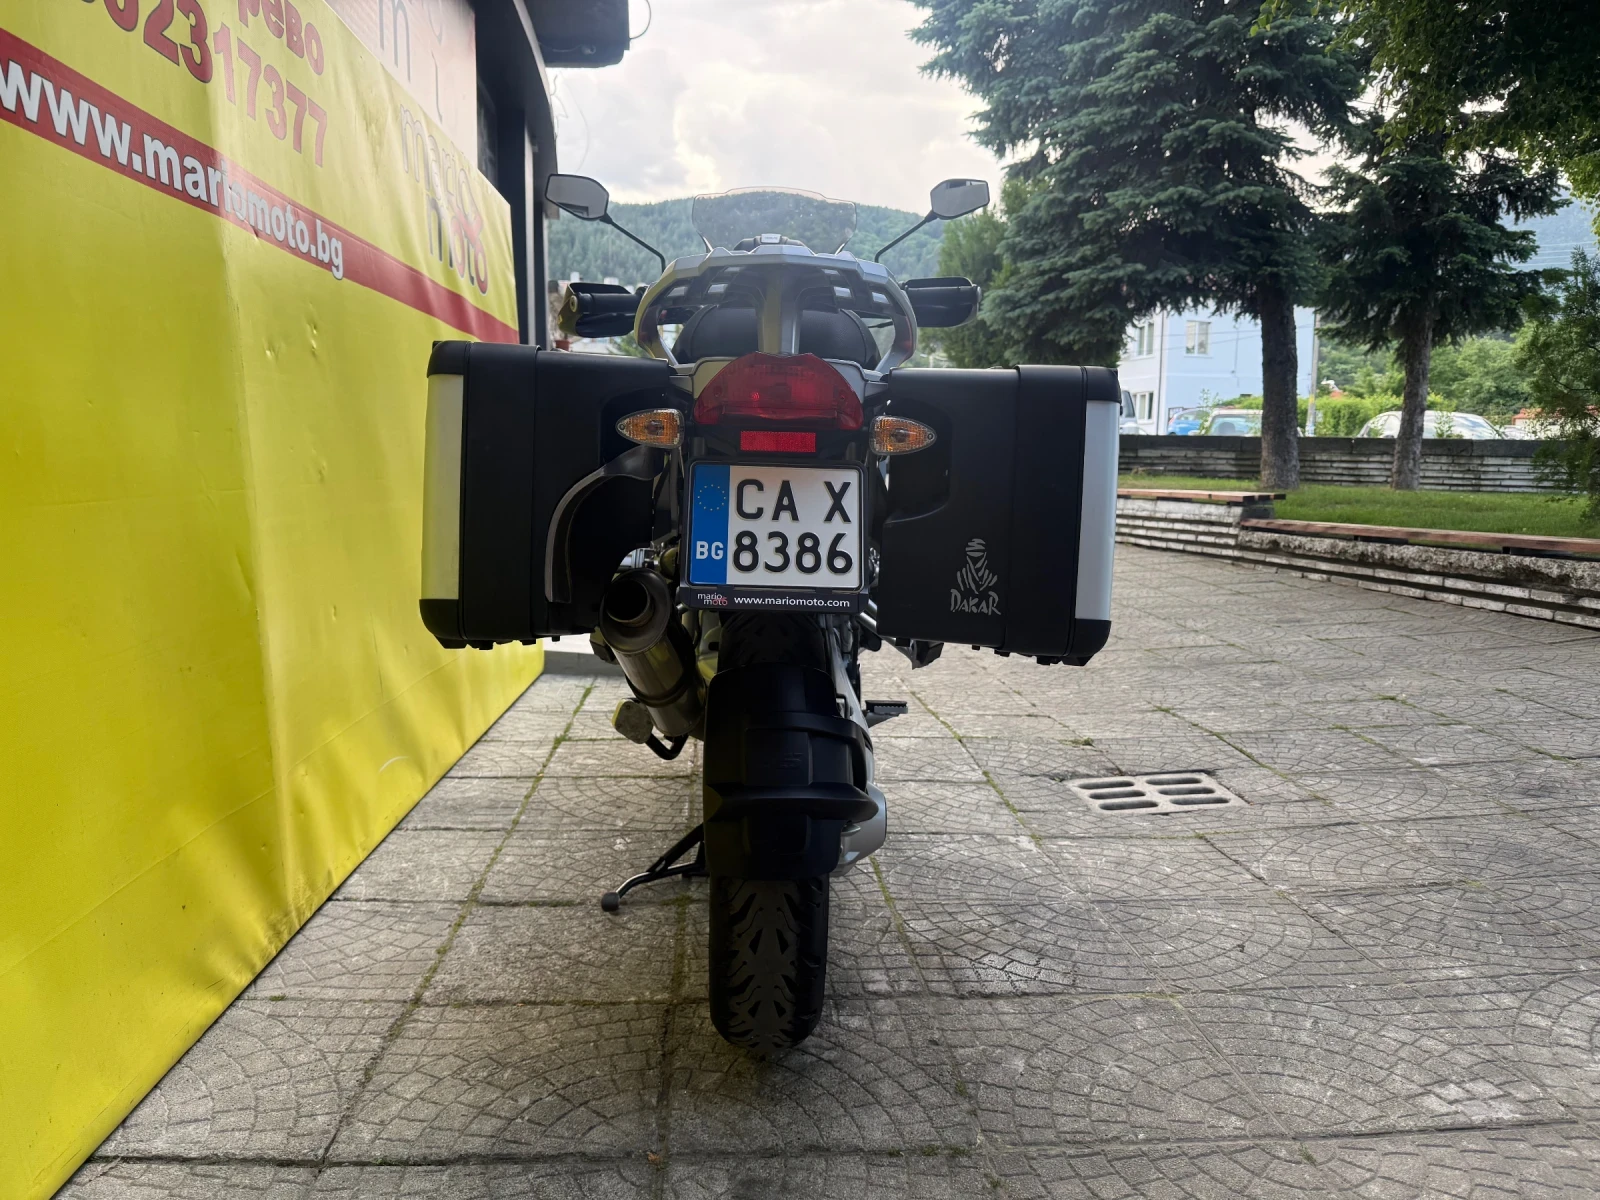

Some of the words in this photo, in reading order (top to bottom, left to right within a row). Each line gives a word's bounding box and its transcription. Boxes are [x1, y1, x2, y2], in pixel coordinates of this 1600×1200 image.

[0, 58, 344, 281] www.mariomoto.bg
[426, 193, 489, 295] moto
[823, 480, 852, 524] X
[695, 540, 724, 560] BG
[732, 530, 853, 575] 8386
[697, 592, 723, 601] mario
[703, 598, 728, 606] moto
[733, 595, 851, 608] www.mariomoto.com
[950, 588, 1002, 616] DAKAR
